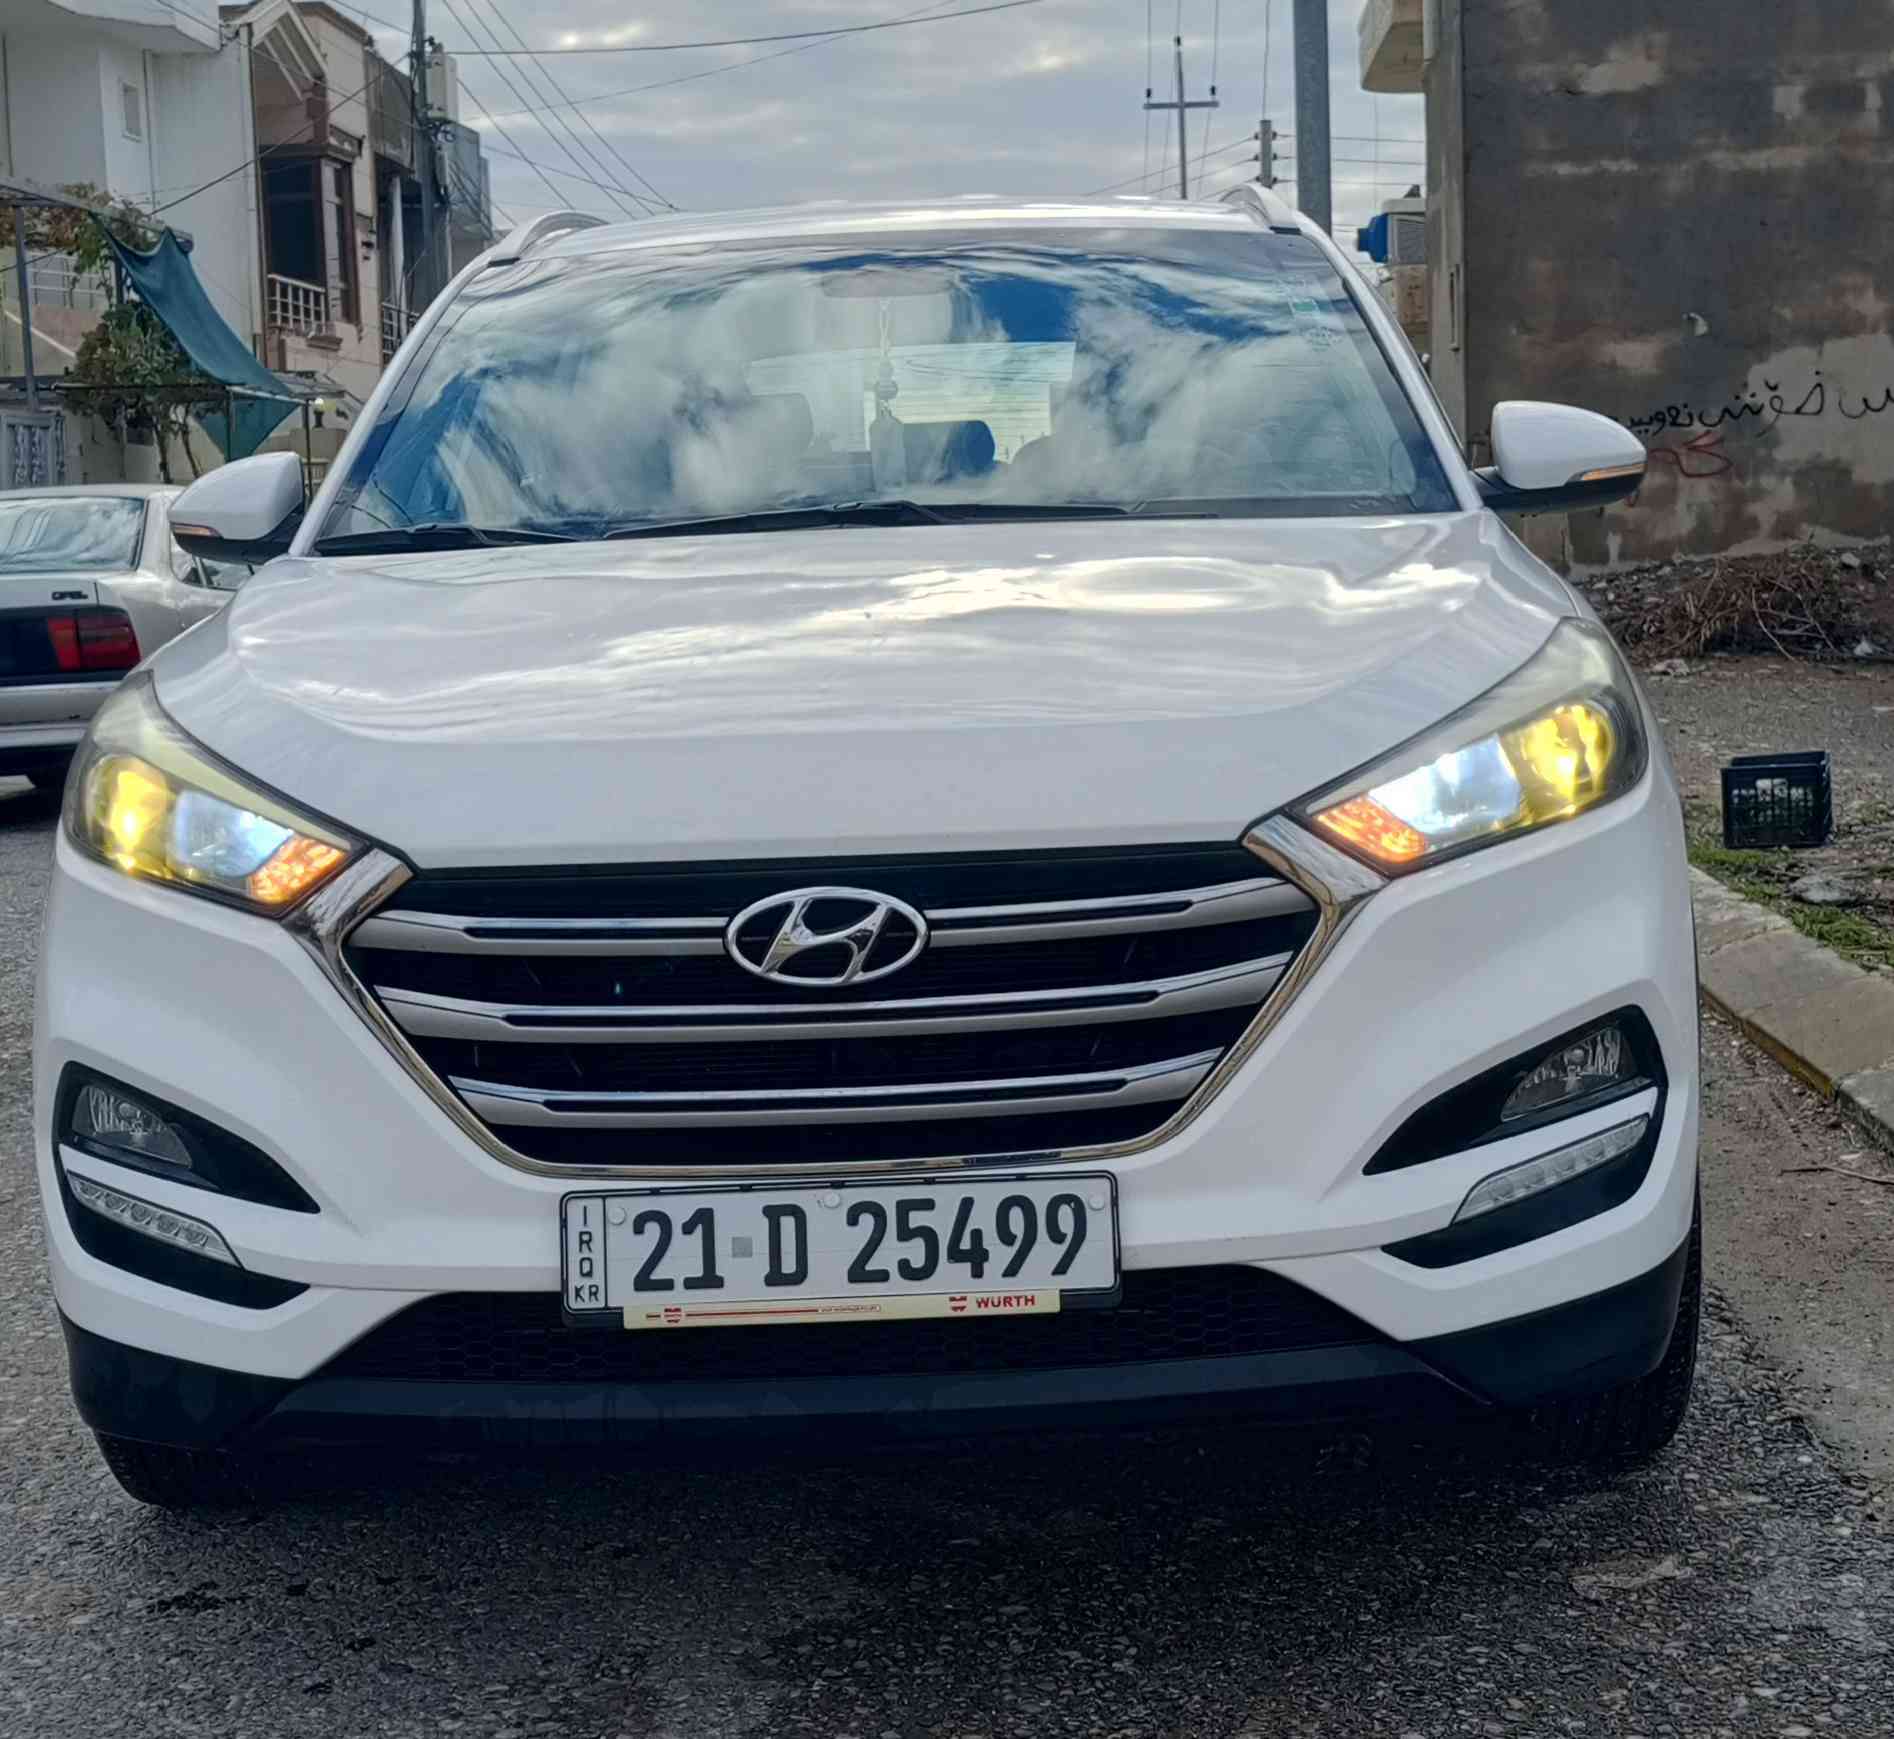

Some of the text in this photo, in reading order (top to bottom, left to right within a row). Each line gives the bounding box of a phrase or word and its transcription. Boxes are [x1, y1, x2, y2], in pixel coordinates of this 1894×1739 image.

[631, 1192, 1088, 1292] 21 D 25499
[574, 1283, 600, 1303] KR
